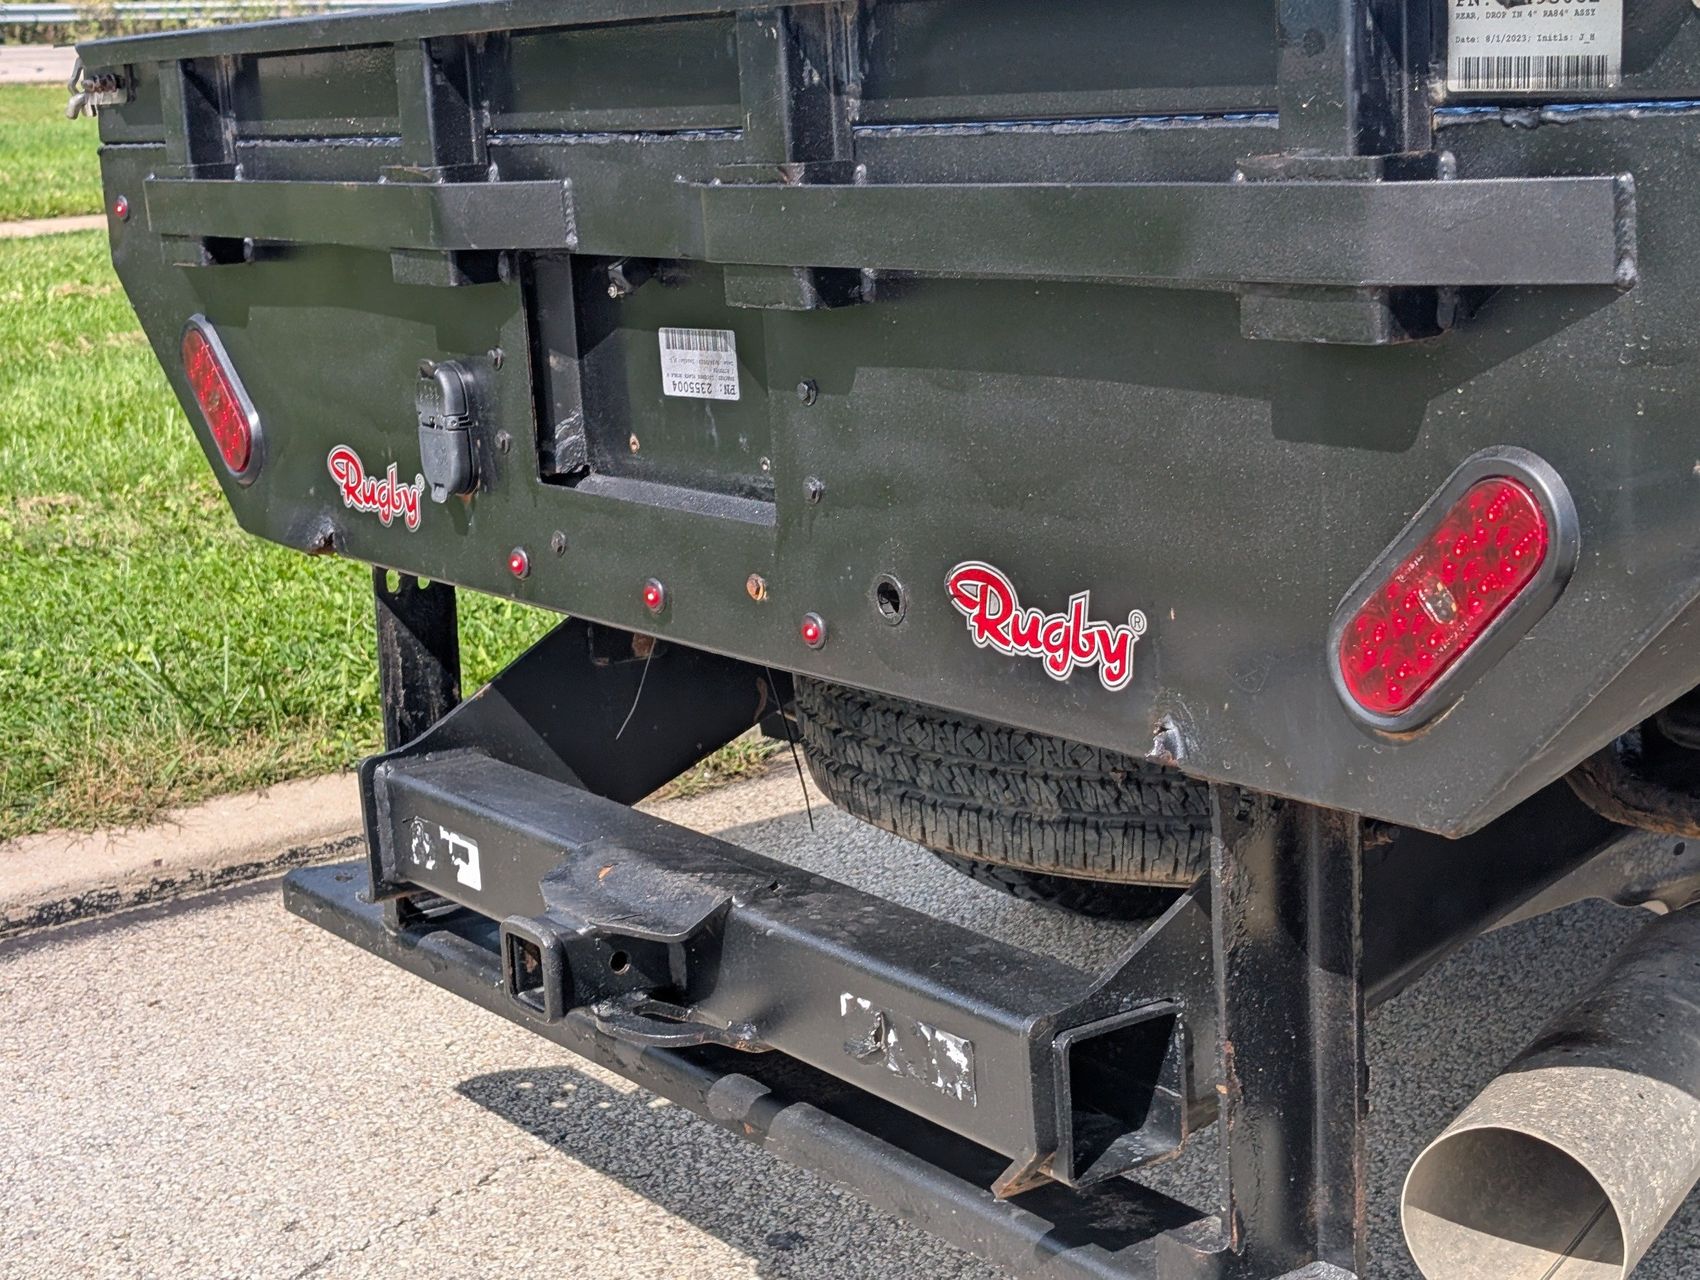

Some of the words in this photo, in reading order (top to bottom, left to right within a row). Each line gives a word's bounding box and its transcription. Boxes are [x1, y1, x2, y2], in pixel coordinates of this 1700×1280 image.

[1455, 11, 1480, 20] REAR,
[1485, 11, 1507, 19] DROP
[1512, 10, 1523, 18] IN
[1573, 8, 1596, 17] ASSY
[1455, 35, 1480, 43] Date:
[1536, 32, 1573, 42] Initls:
[672, 380, 713, 394] 2355004
[720, 383, 737, 395] PN:
